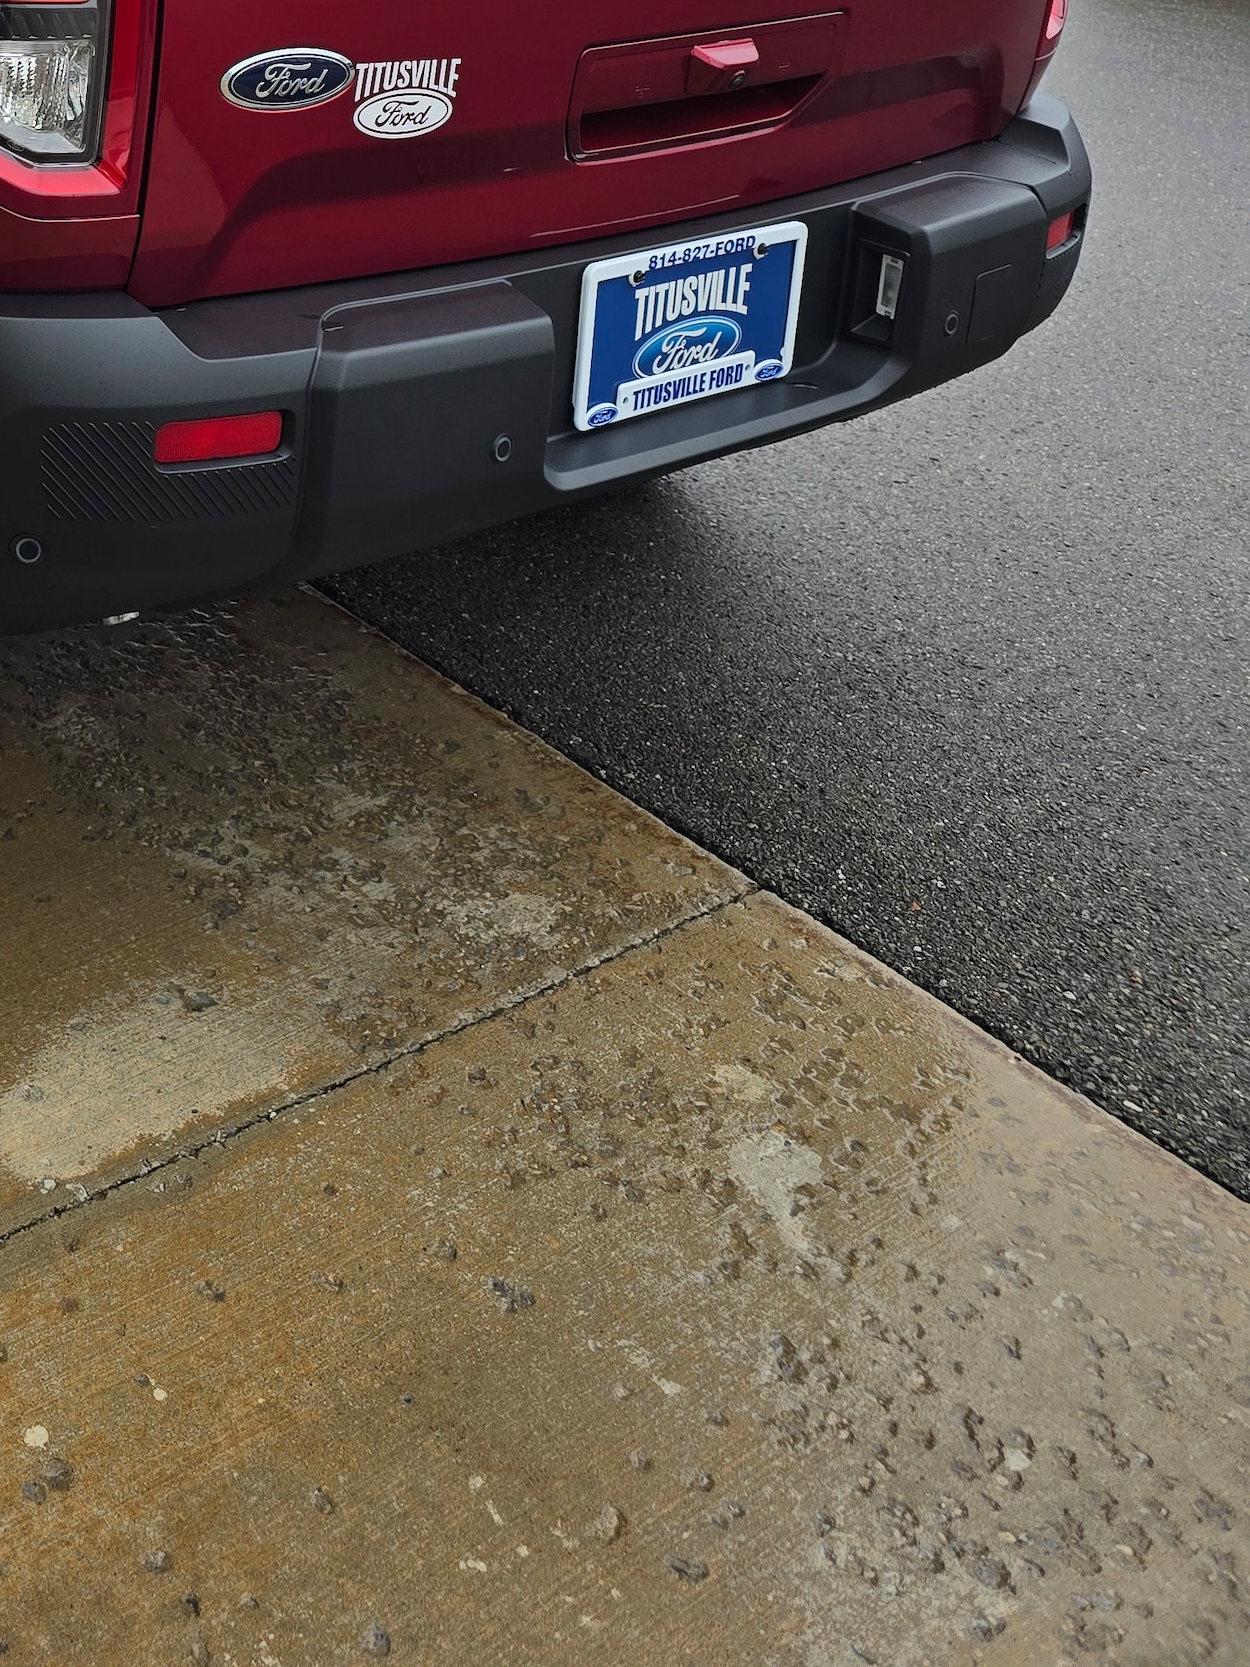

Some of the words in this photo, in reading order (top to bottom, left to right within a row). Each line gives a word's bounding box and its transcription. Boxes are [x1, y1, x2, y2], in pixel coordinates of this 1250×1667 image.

[255, 62, 329, 98] Ford
[354, 58, 462, 103] TITUSVILLE
[374, 100, 432, 128] Ford
[649, 235, 757, 270] 814-827-FORD
[635, 263, 753, 342] TITUSVILLE
[652, 326, 723, 375] Ford
[632, 372, 707, 411] TITUSVILLE
[709, 362, 744, 387] FORD
